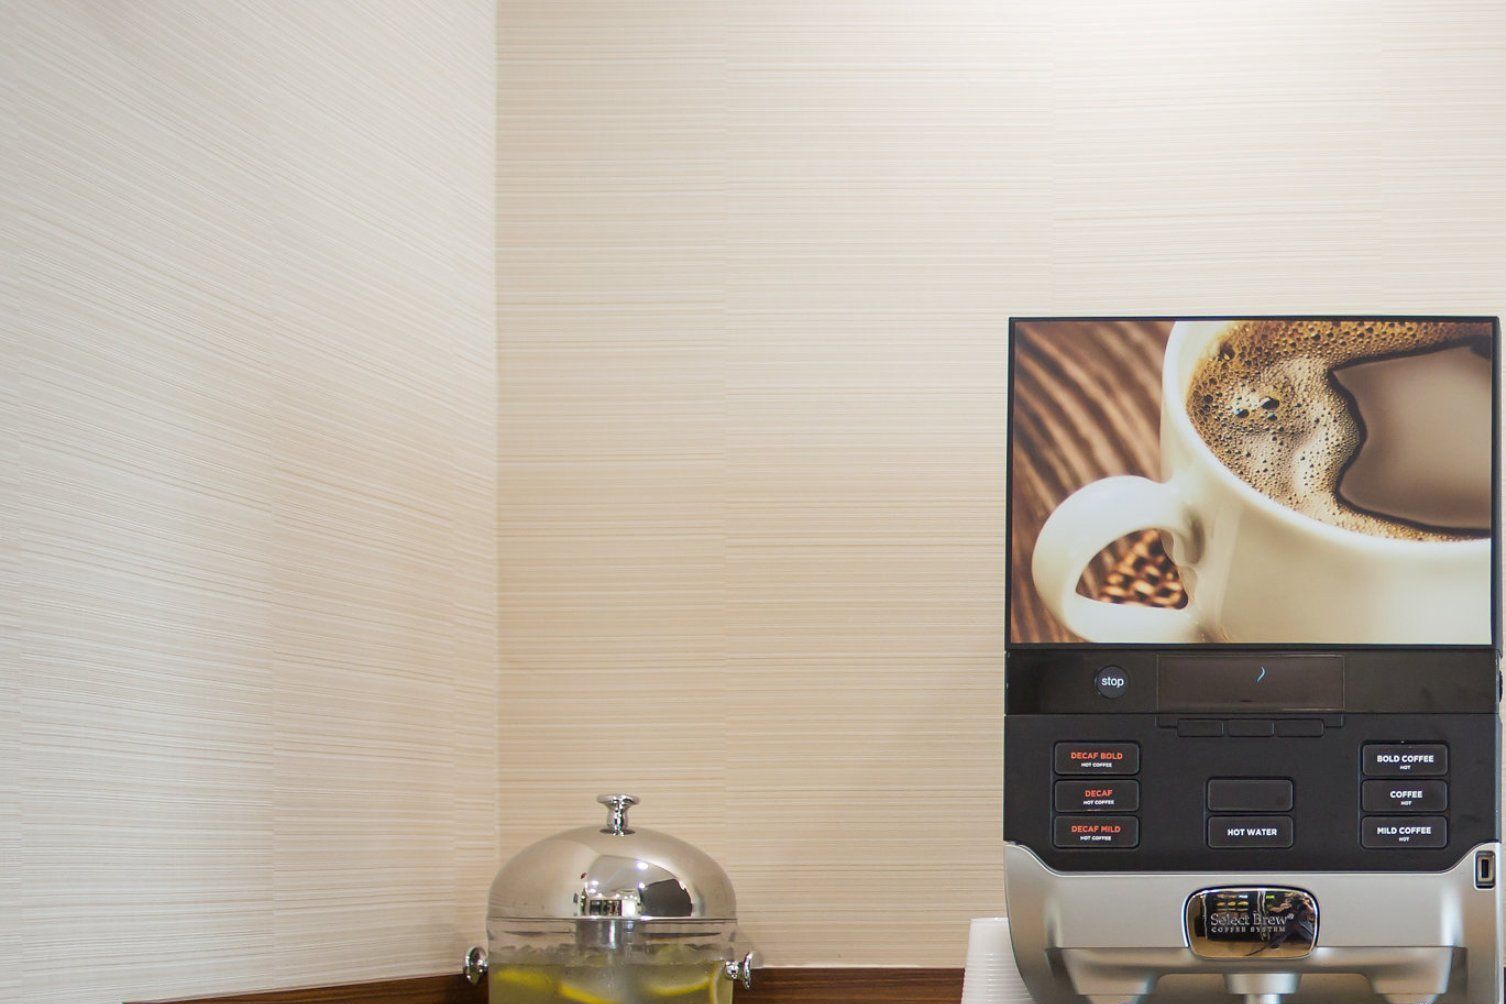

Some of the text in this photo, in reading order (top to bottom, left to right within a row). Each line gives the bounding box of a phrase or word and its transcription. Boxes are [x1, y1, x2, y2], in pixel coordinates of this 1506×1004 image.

[1101, 676, 1124, 688] stop
[1070, 752, 1123, 760] DECAF BOLD
[1377, 755, 1434, 763] BOLD COFFEE
[1085, 789, 1113, 797] DECAF
[1071, 825, 1121, 833] DECAF MILD
[1227, 828, 1278, 836] HOT WATER
[1210, 912, 1250, 926] Select
